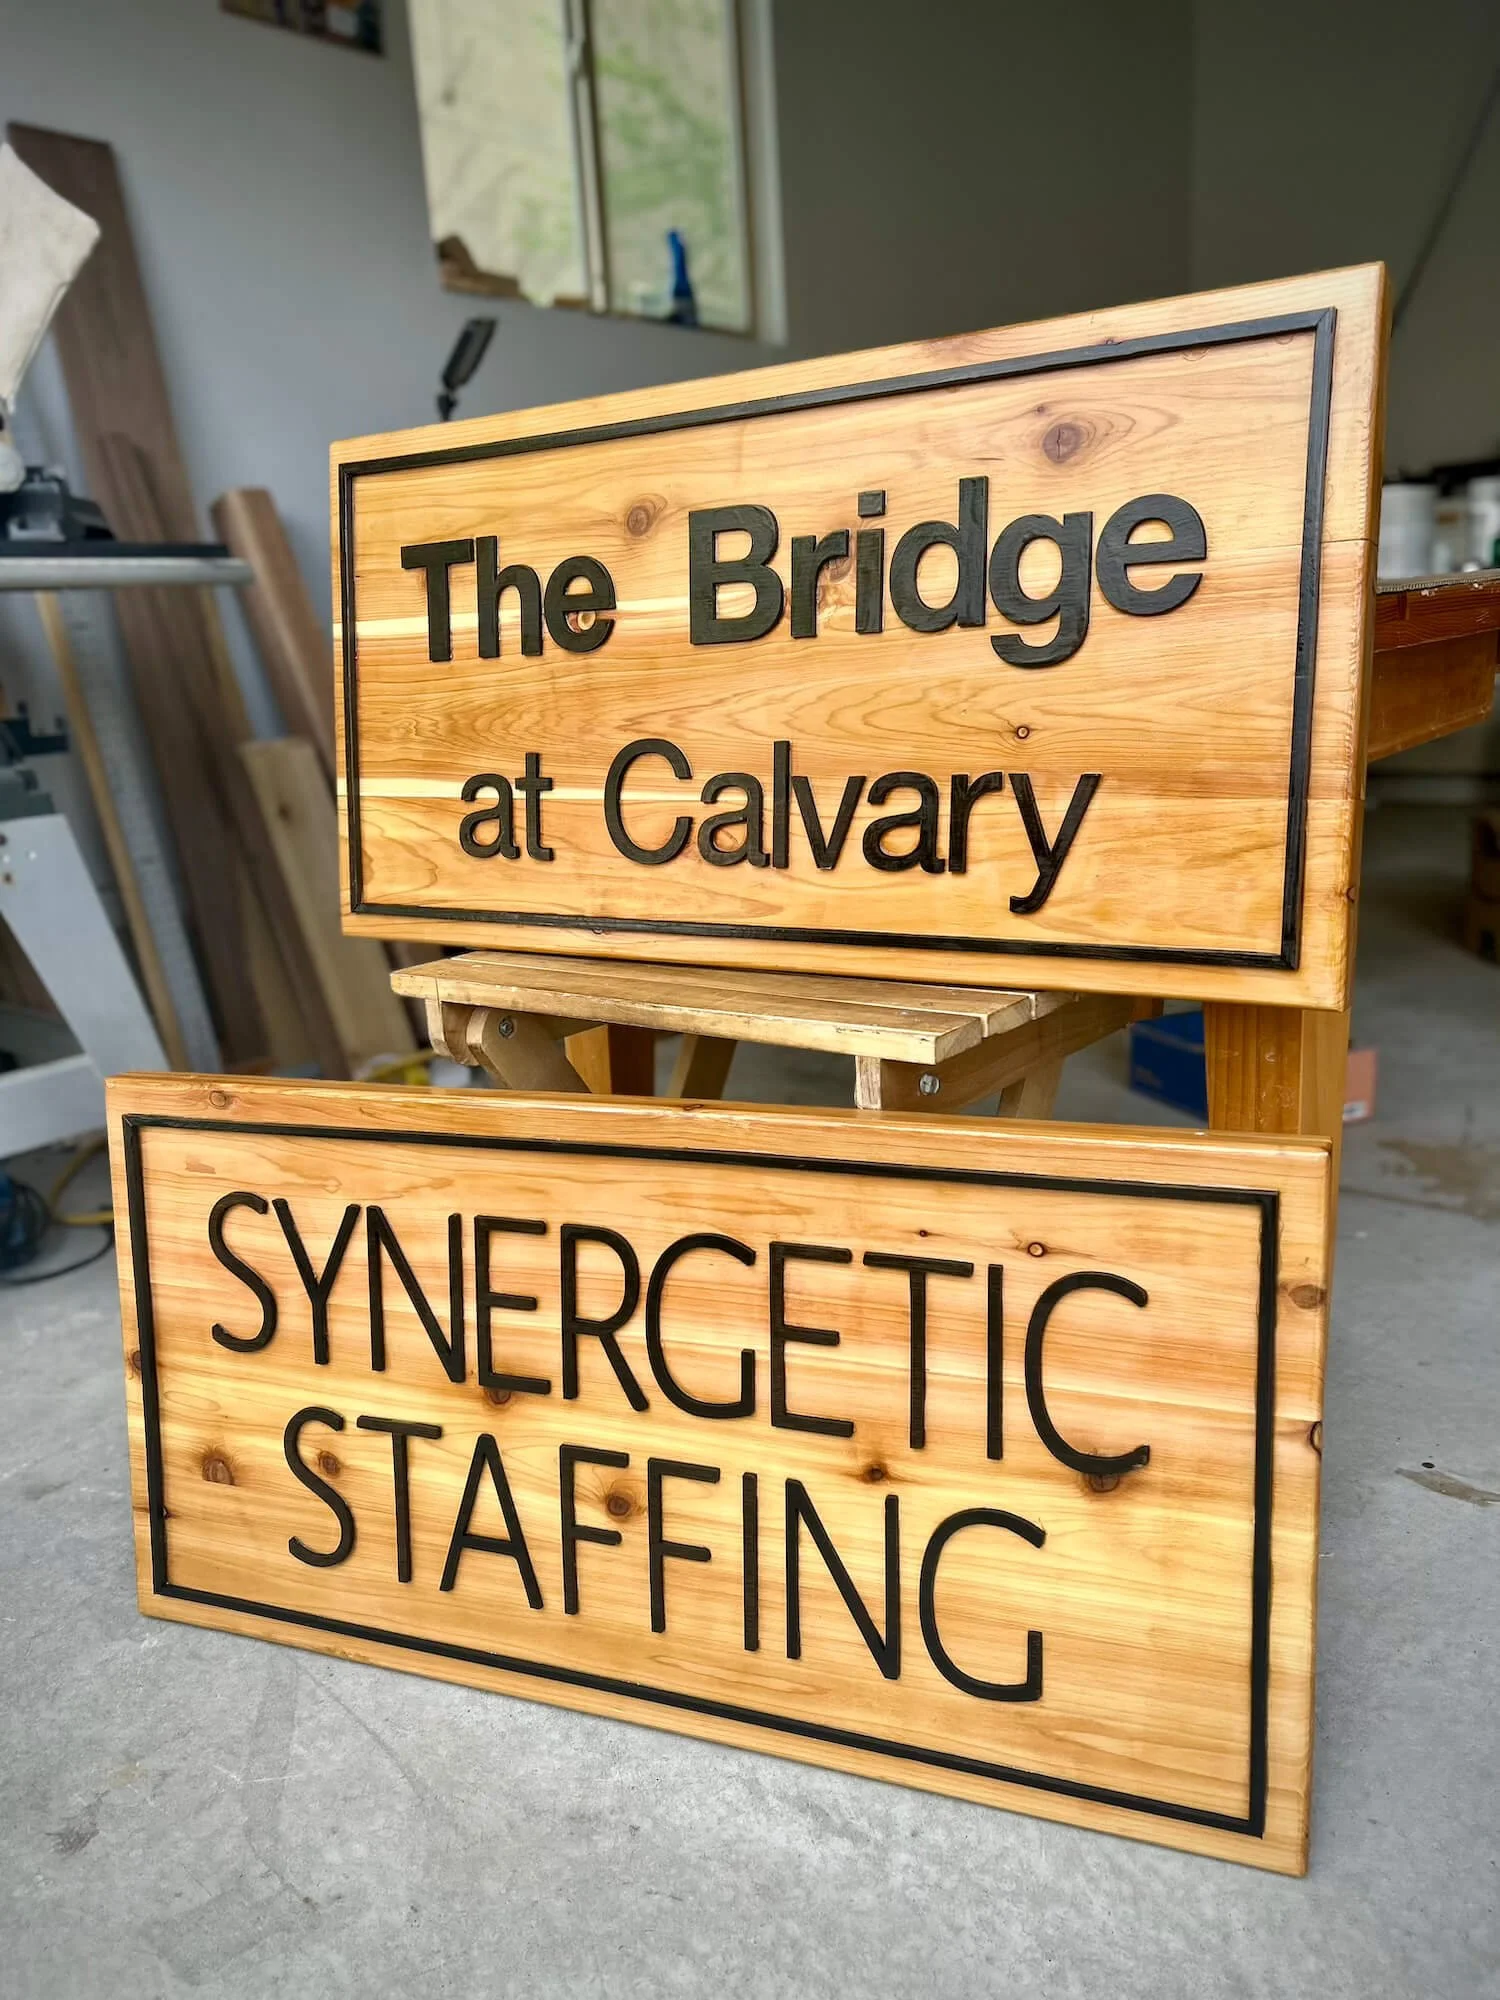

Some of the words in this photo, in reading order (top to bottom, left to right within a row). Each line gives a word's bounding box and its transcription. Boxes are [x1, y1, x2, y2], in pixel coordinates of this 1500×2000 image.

[401, 536, 616, 663] The
[688, 476, 1208, 667] Bridge
[459, 753, 556, 862] at
[604, 739, 1103, 916] Calvary
[208, 1190, 1151, 1476] SYNERGETIC
[285, 1407, 1047, 1703] STAFFING
